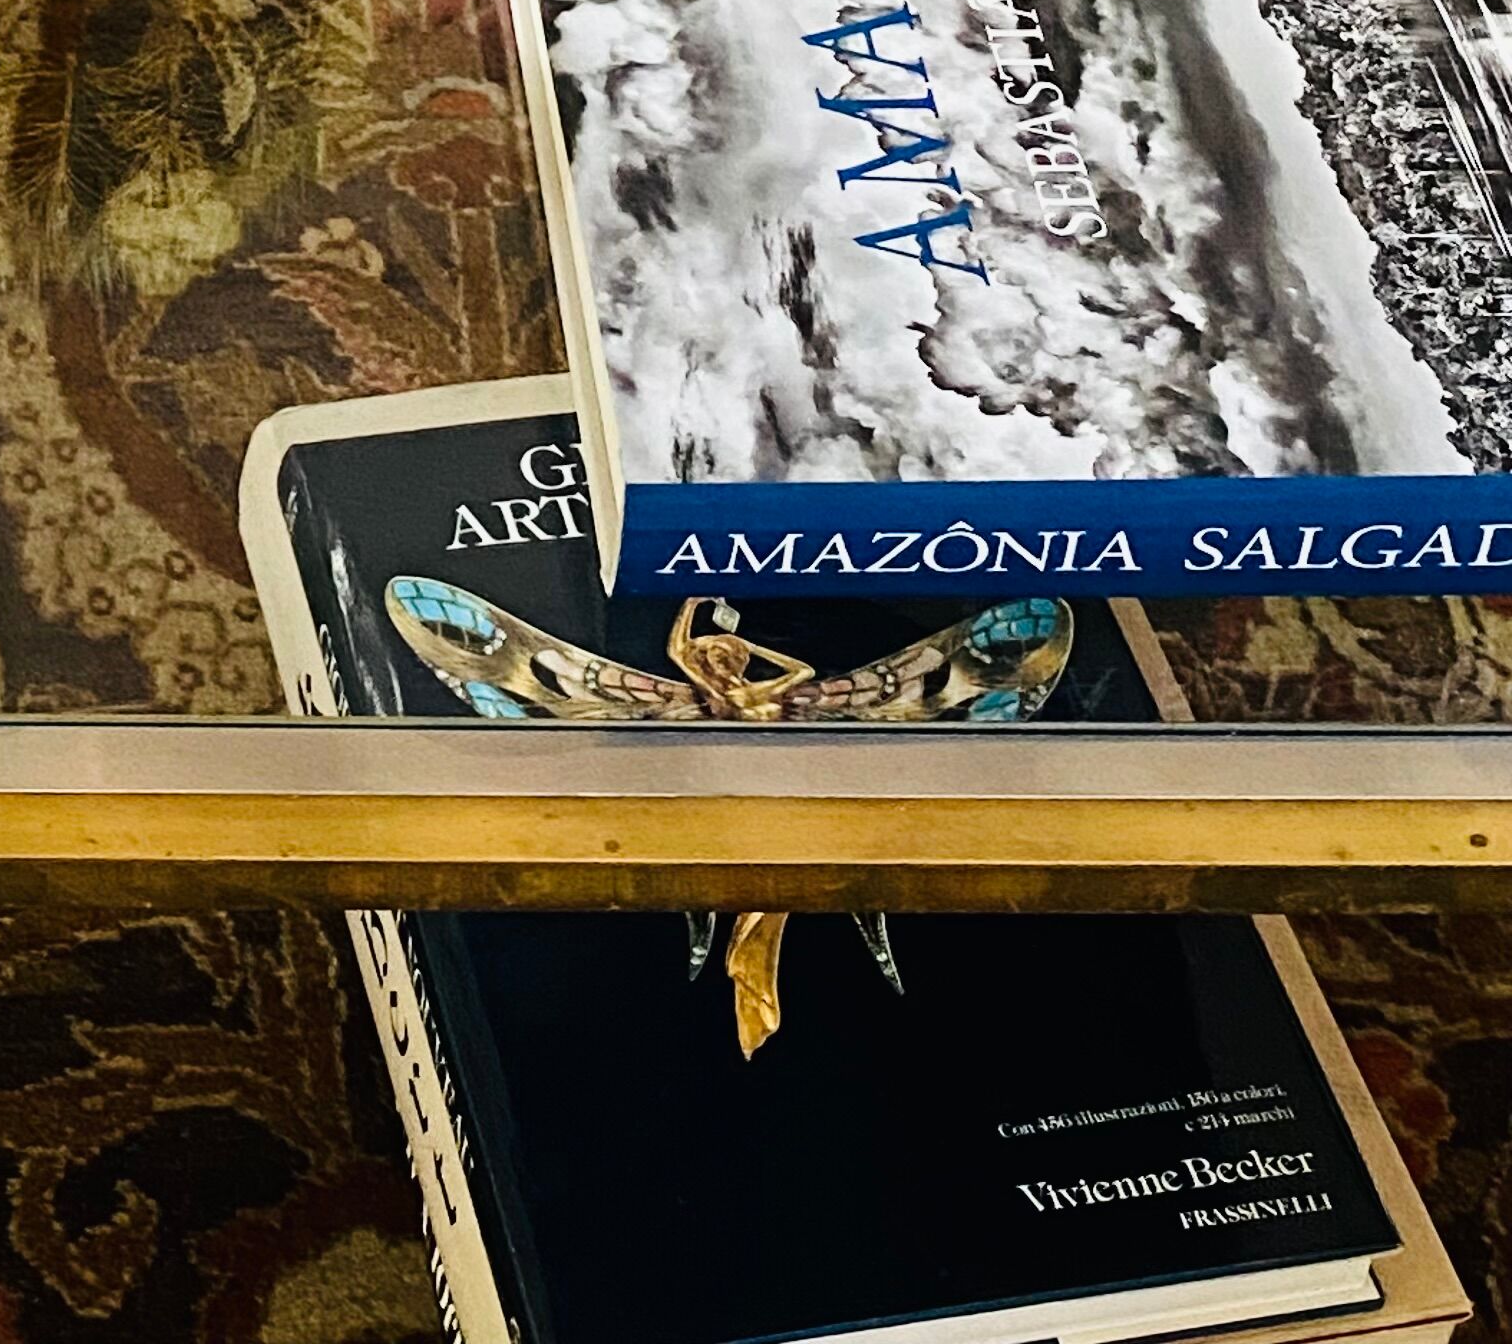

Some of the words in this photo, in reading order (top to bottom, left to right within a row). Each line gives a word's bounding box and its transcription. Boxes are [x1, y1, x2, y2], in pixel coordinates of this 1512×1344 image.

[445, 491, 590, 551] ART
[654, 520, 1144, 575] AMAZÔNIA
[1016, 1167, 1184, 1213] Vivienne
[1181, 1148, 1315, 1190] Becker
[1178, 1192, 1334, 1230] FRASSINELLI
